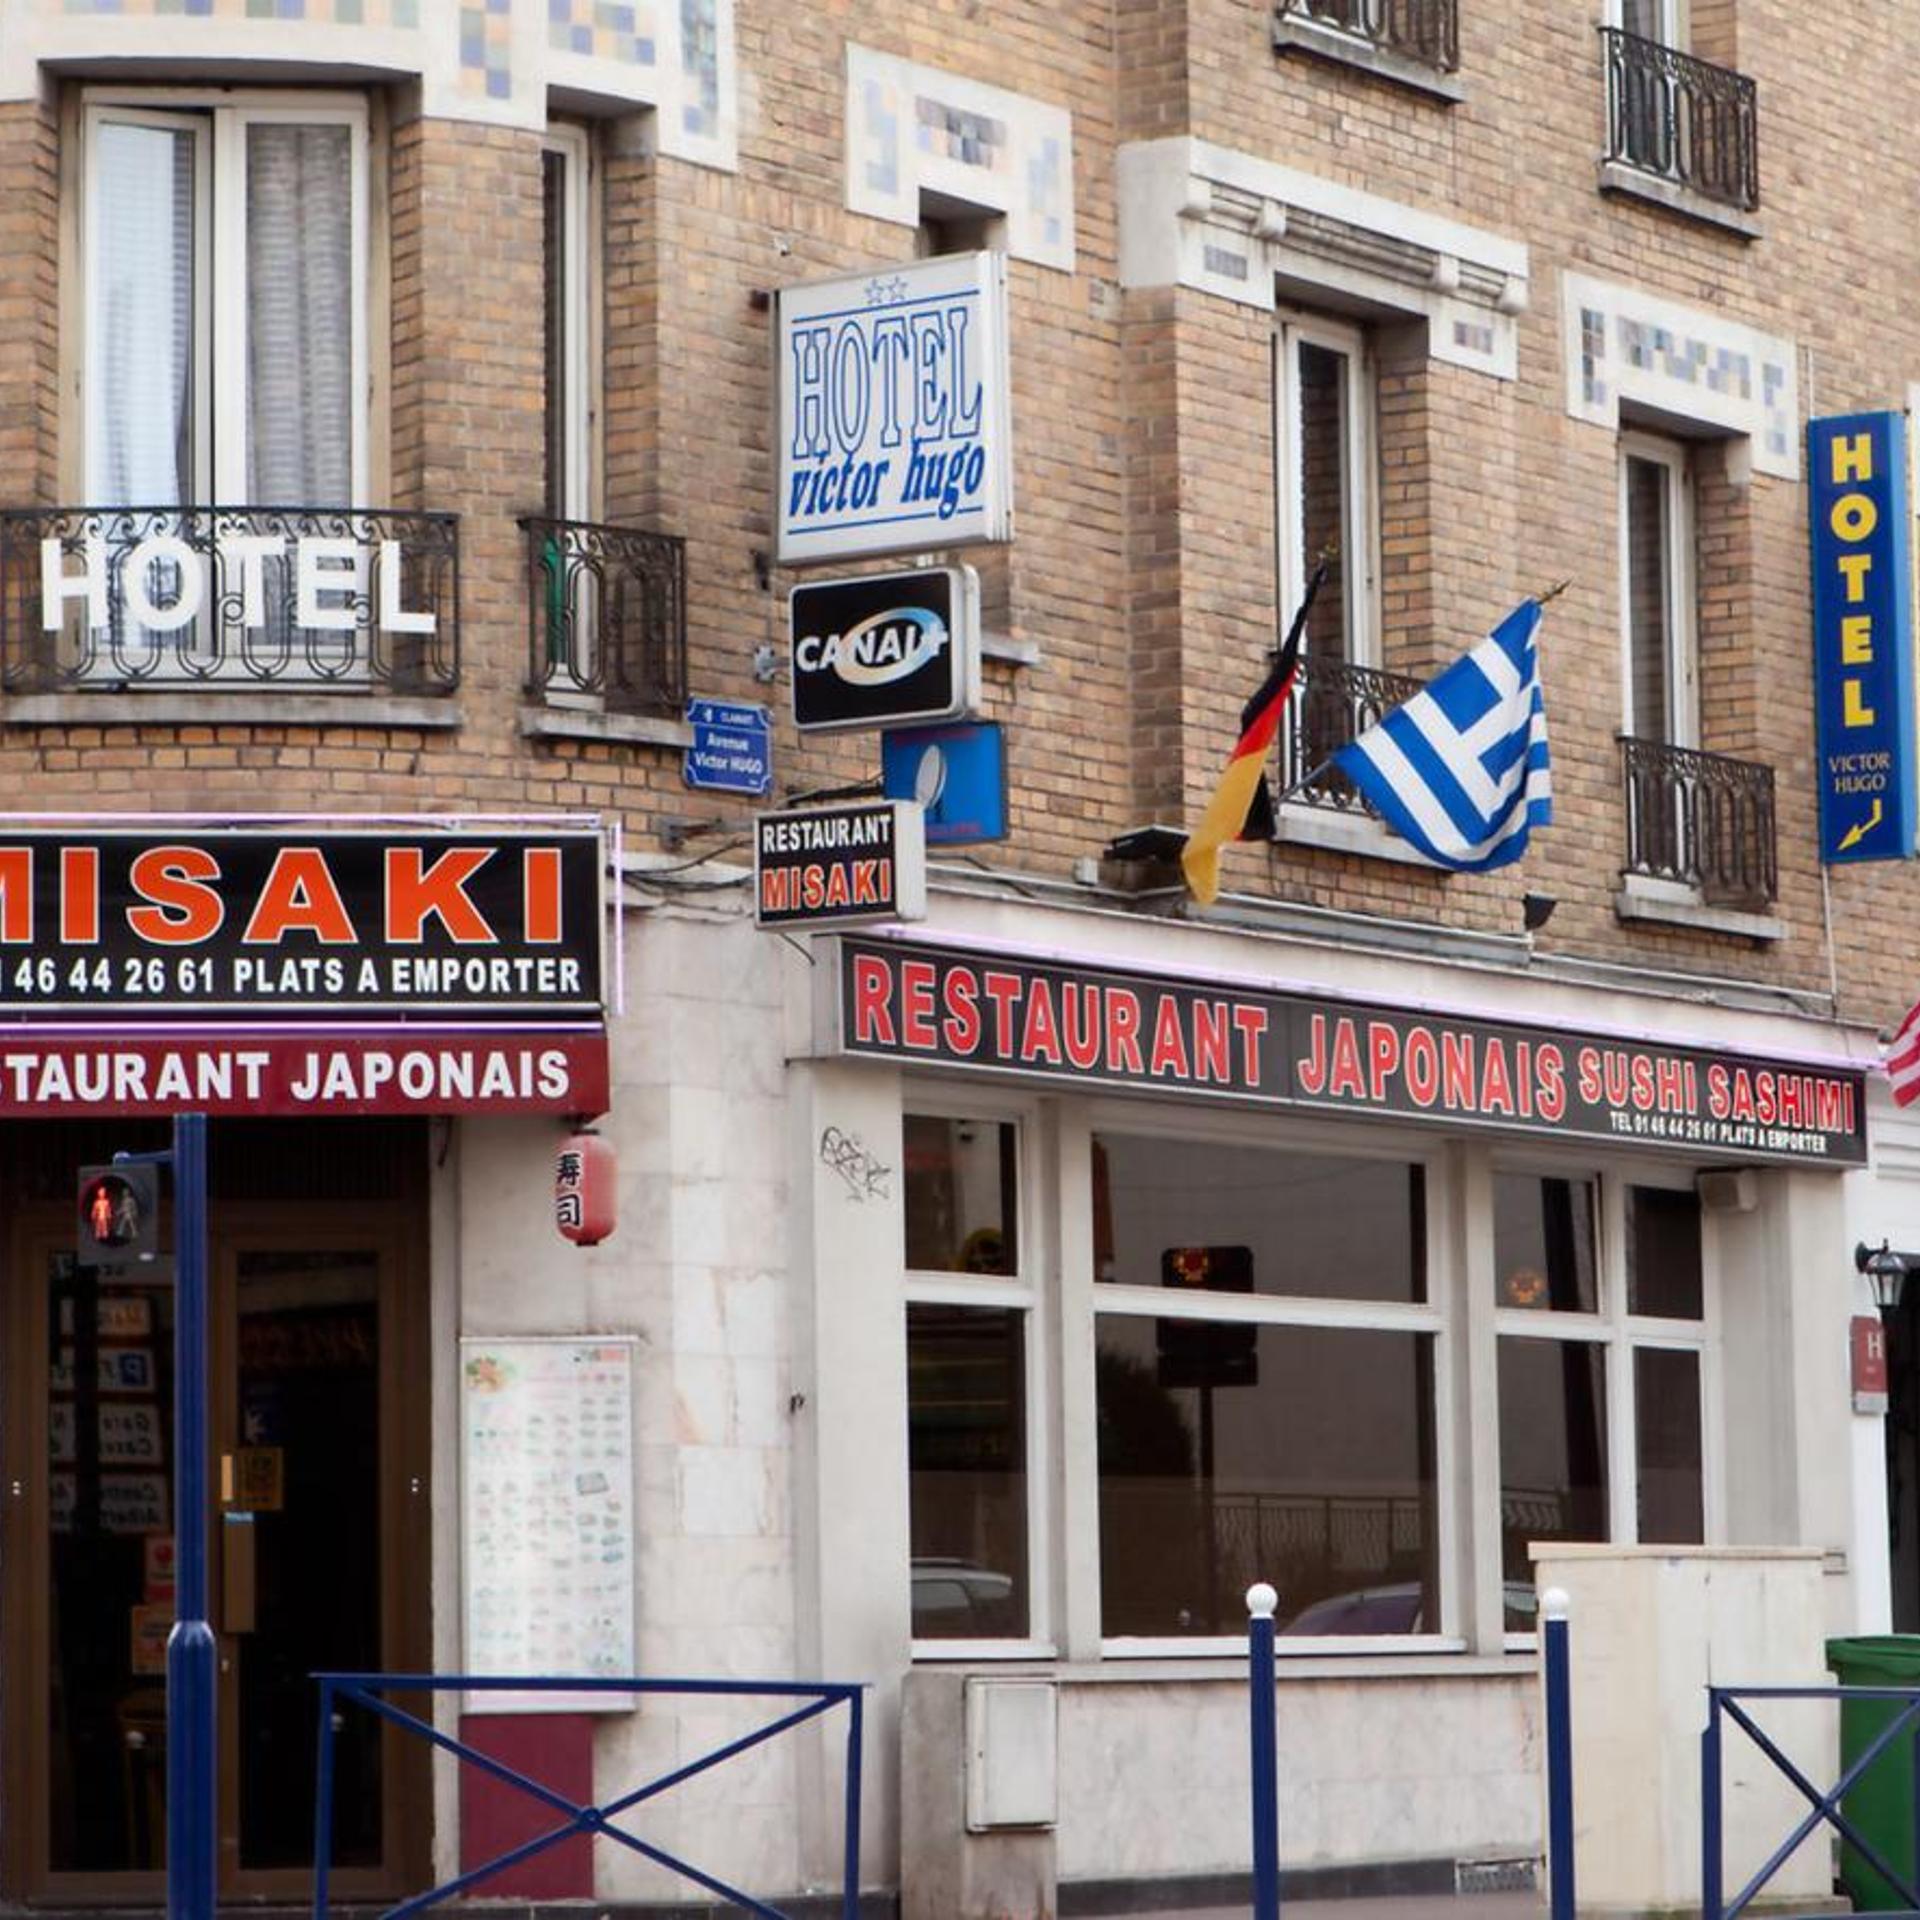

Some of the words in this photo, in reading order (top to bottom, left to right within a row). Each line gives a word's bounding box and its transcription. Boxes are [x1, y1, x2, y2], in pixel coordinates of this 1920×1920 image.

[792, 306, 983, 460] HOTEL
[789, 453, 889, 517] victor
[901, 440, 985, 520] hugo
[41, 536, 436, 634] HOTEL
[1831, 433, 1878, 728] HOTEL
[694, 752, 728, 769] Victor
[730, 756, 763, 774] HUGO
[707, 732, 749, 751] Avenue
[1828, 751, 1891, 774] VICTOR
[1834, 765, 1886, 793] HUGO
[762, 814, 892, 853] RESTAURANT
[762, 859, 892, 912] MISAKI
[14, 957, 57, 993] 46
[68, 957, 112, 993] 44
[124, 957, 165, 993] 26
[177, 957, 214, 993] 61
[233, 957, 345, 993] PLATS
[357, 957, 380, 993] A
[391, 957, 581, 993] EMPORTER
[853, 953, 1267, 1087] RESTAURANT
[1298, 1014, 1567, 1122] JAPONAIS
[1578, 1046, 1697, 1116] SUSHI
[1708, 1064, 1855, 1135] SASHIMI
[0, 1052, 270, 1101] TAURANT
[291, 1051, 570, 1100] JAPONAIS
[1610, 1111, 1632, 1132] TEL
[1720, 1122, 1756, 1146] PLATS
[1768, 1130, 1827, 1153] EMPORTER
